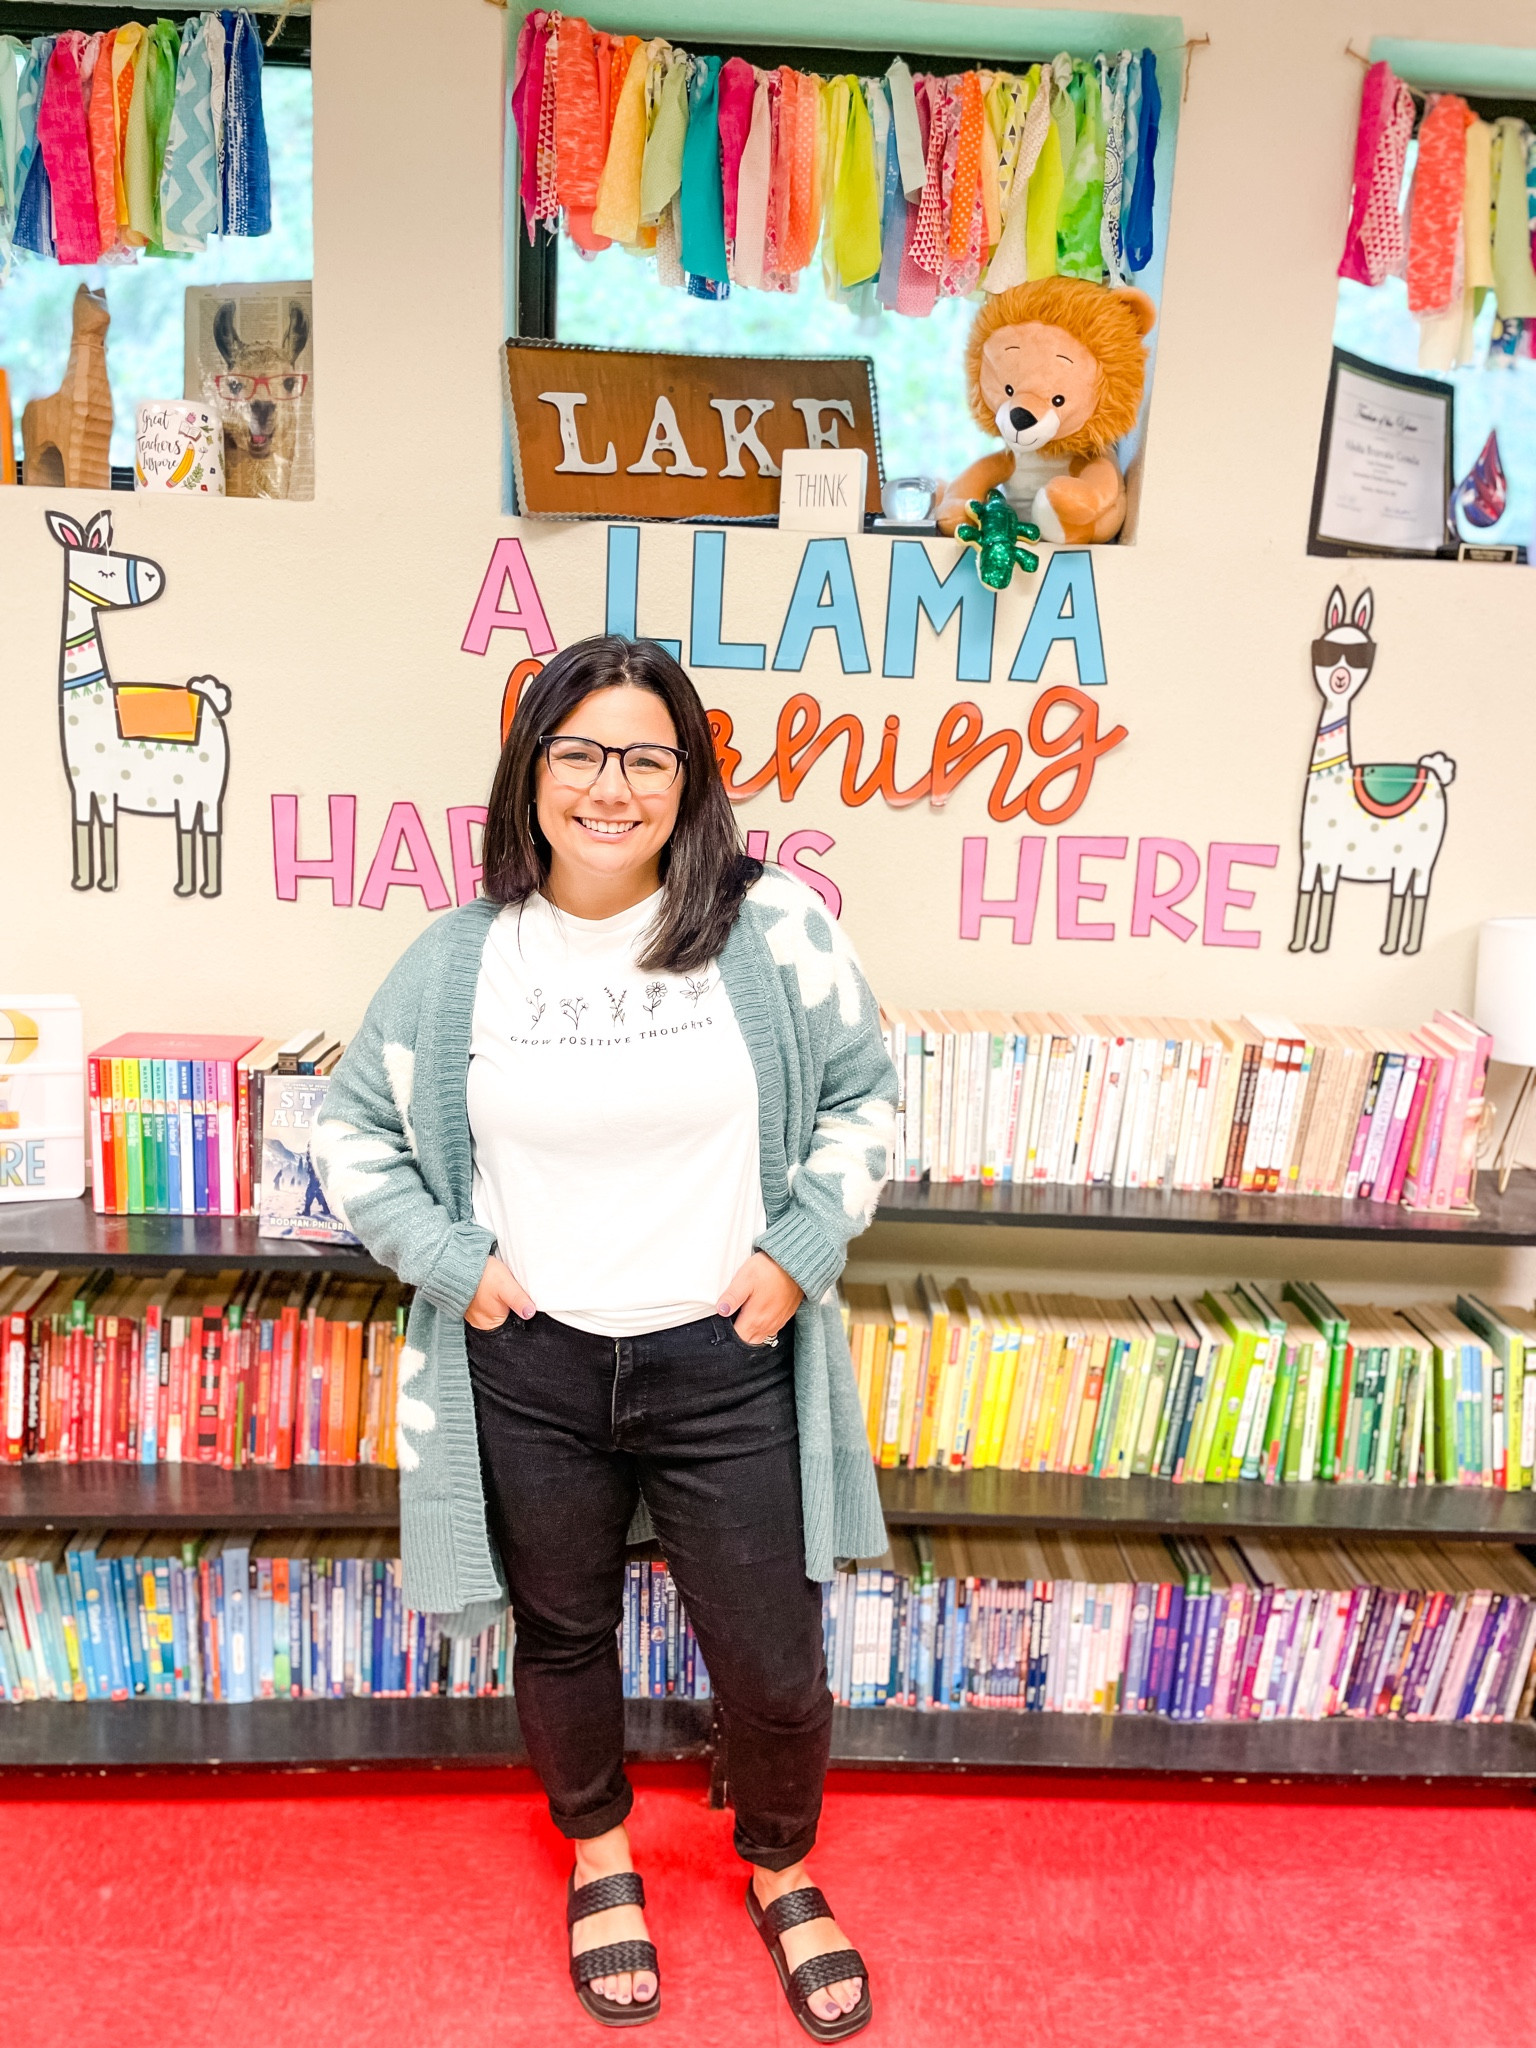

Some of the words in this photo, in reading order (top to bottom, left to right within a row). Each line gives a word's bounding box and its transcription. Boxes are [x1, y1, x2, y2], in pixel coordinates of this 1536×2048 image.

[142, 409, 175, 433] Great
[137, 434, 181, 455] Teachers
[142, 452, 177, 475] Inspire
[795, 474, 847, 507] THINK
[461, 538, 558, 657] A
[605, 525, 1107, 686] LLAMA
[960, 835, 1280, 949] HERE
[510, 1035, 551, 1046] GROW
[560, 1036, 631, 1046] POSITIVE
[639, 1017, 713, 1040] THOUGHTS
[280, 1091, 327, 1109] ST
[270, 1218, 310, 1228] RODMAN
[653, 1578, 661, 1601] Santa
[653, 1601, 661, 1623] Paws
